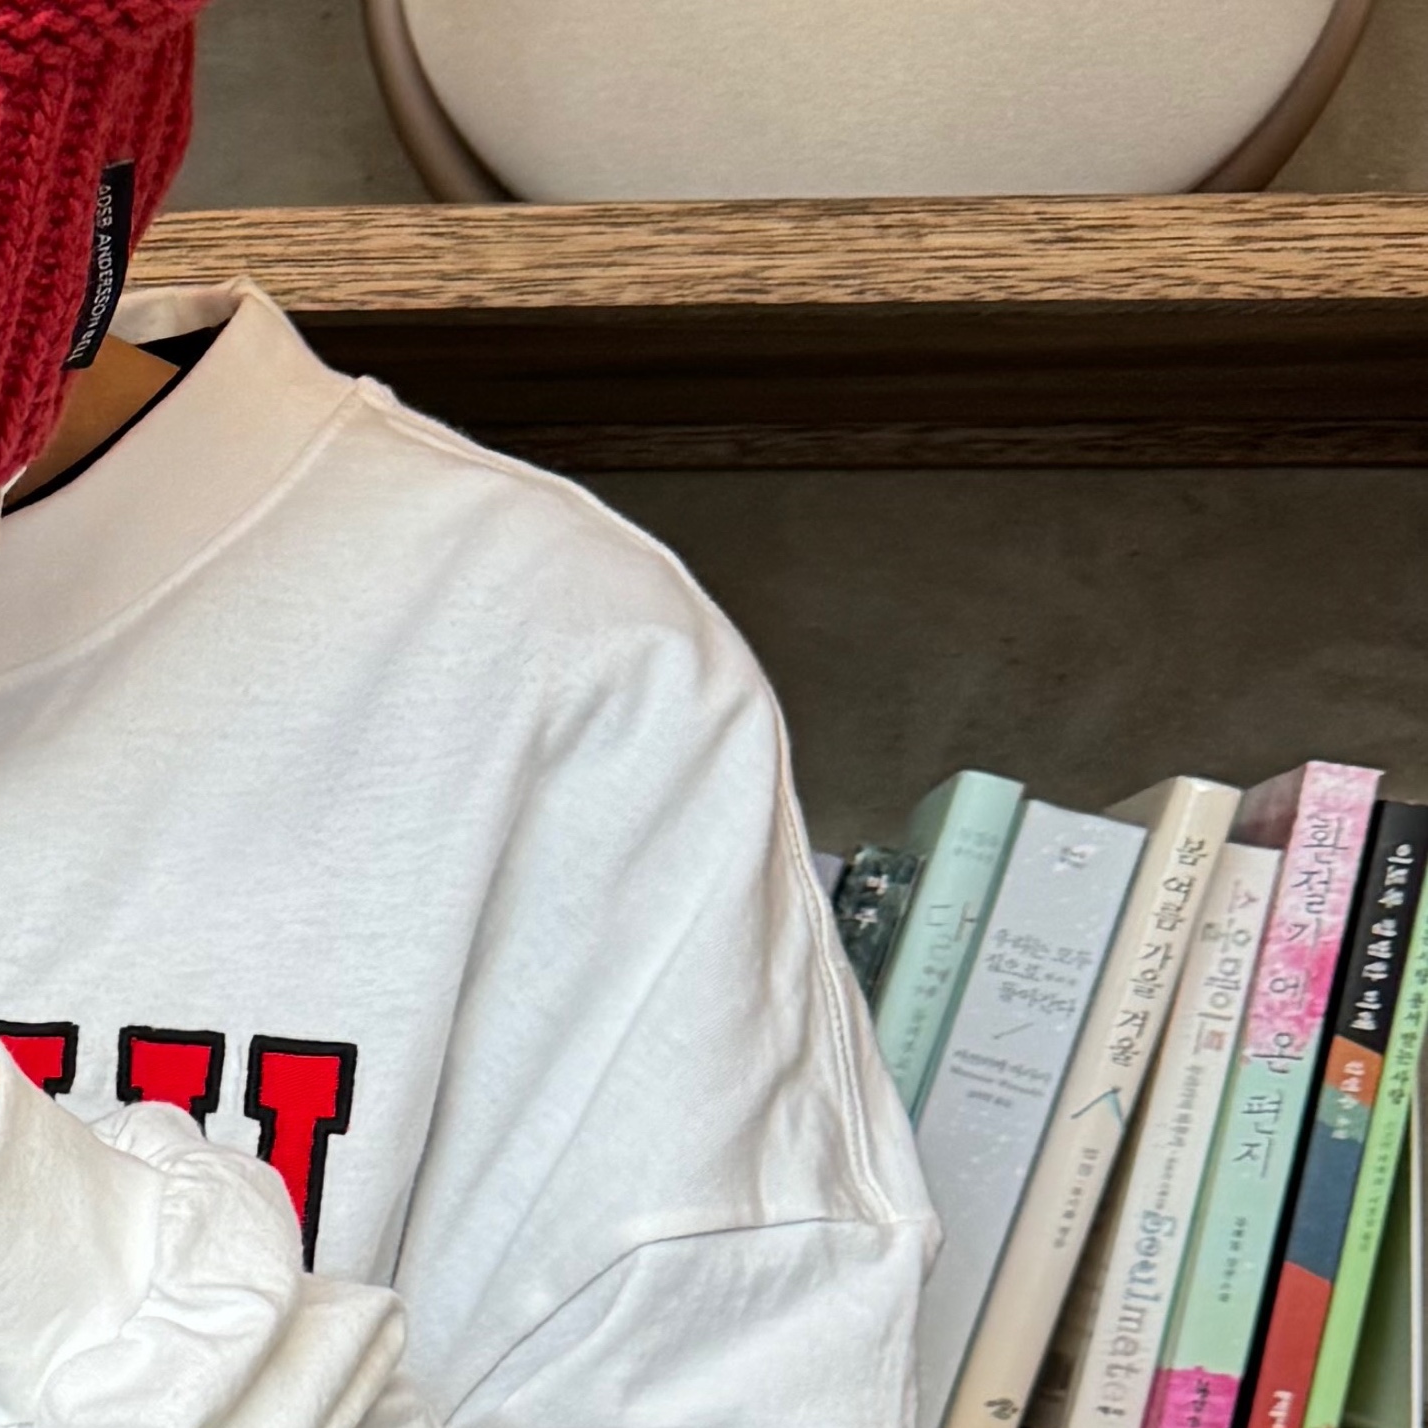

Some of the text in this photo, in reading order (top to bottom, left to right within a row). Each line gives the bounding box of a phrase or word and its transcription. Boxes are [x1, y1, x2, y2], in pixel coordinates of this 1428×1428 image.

[88, 233, 113, 329] ANDERSSON
[1108, 835, 1211, 1068] 봄 여름 가을 겨울
